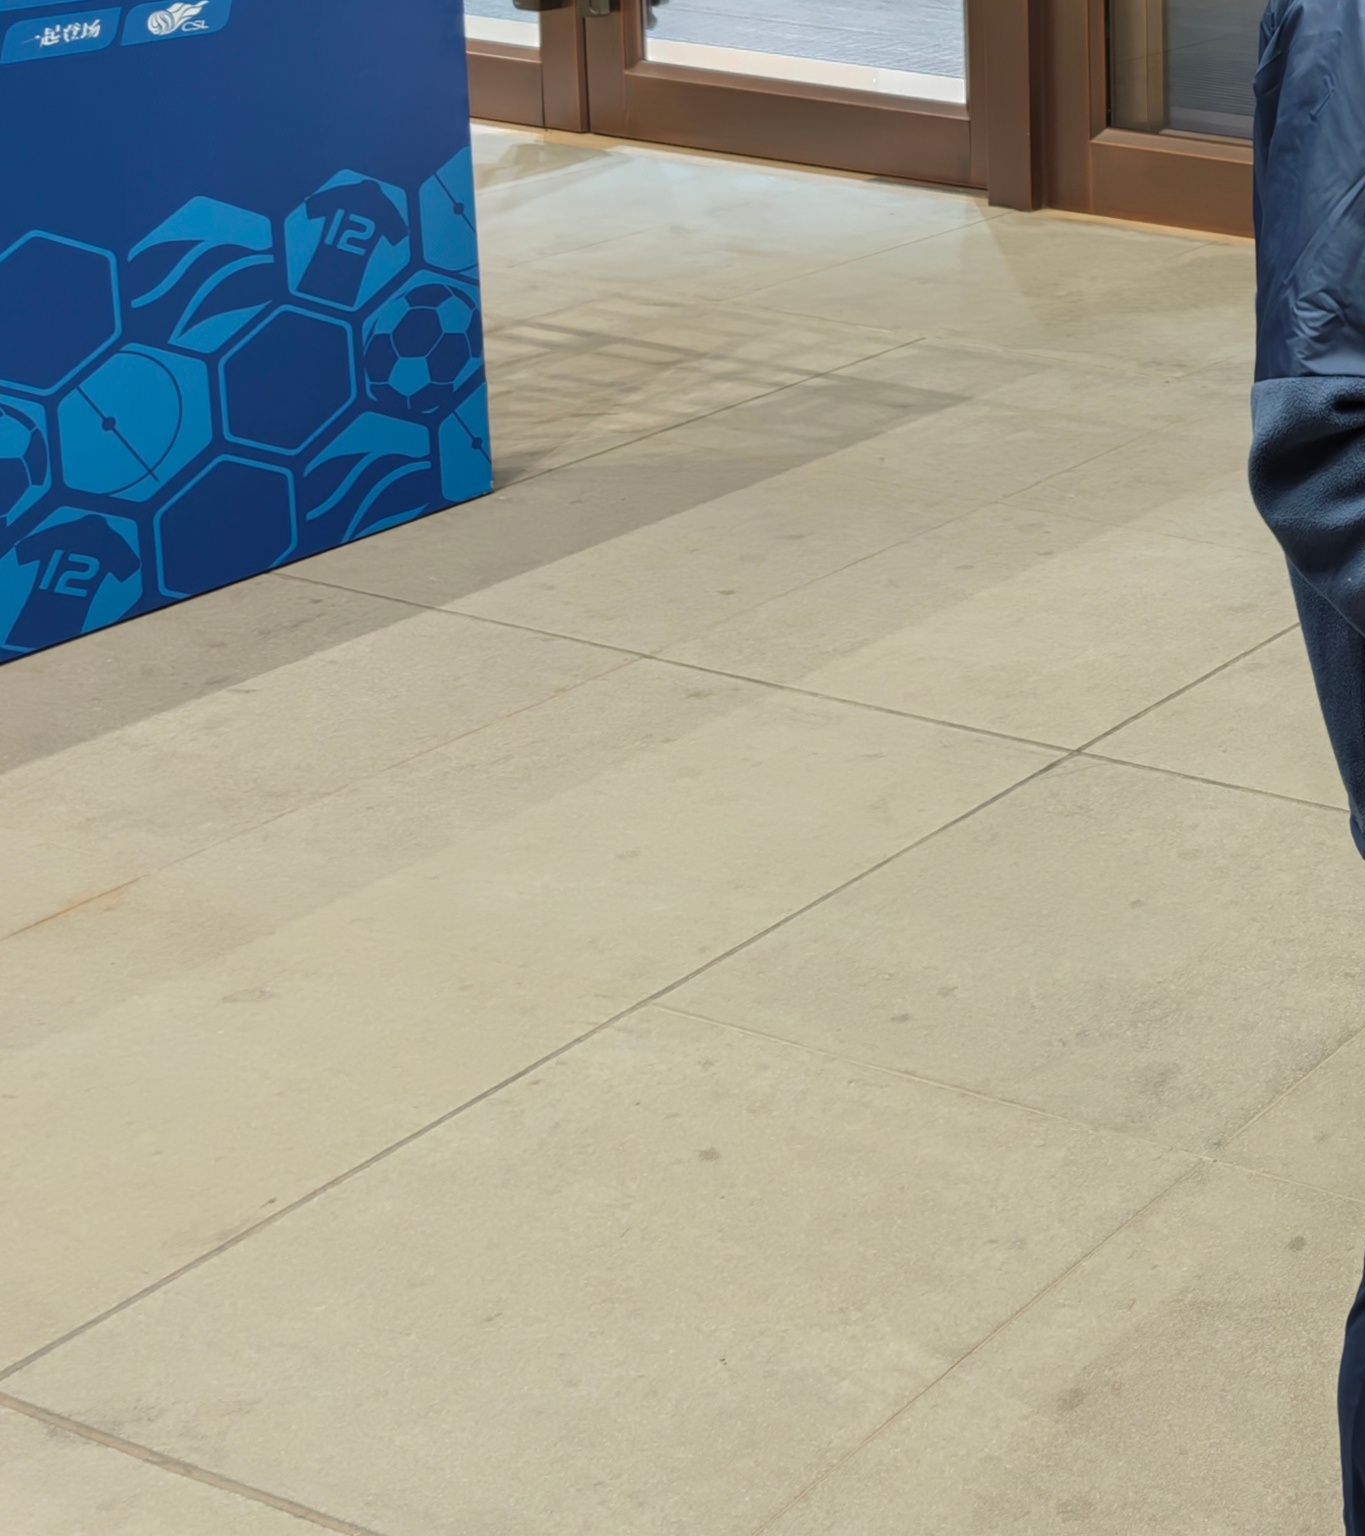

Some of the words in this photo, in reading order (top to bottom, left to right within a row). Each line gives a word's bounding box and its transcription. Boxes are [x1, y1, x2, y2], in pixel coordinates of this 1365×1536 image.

[182, 20, 209, 32] CSL
[325, 208, 376, 256] 12
[39, 550, 99, 598] 12
